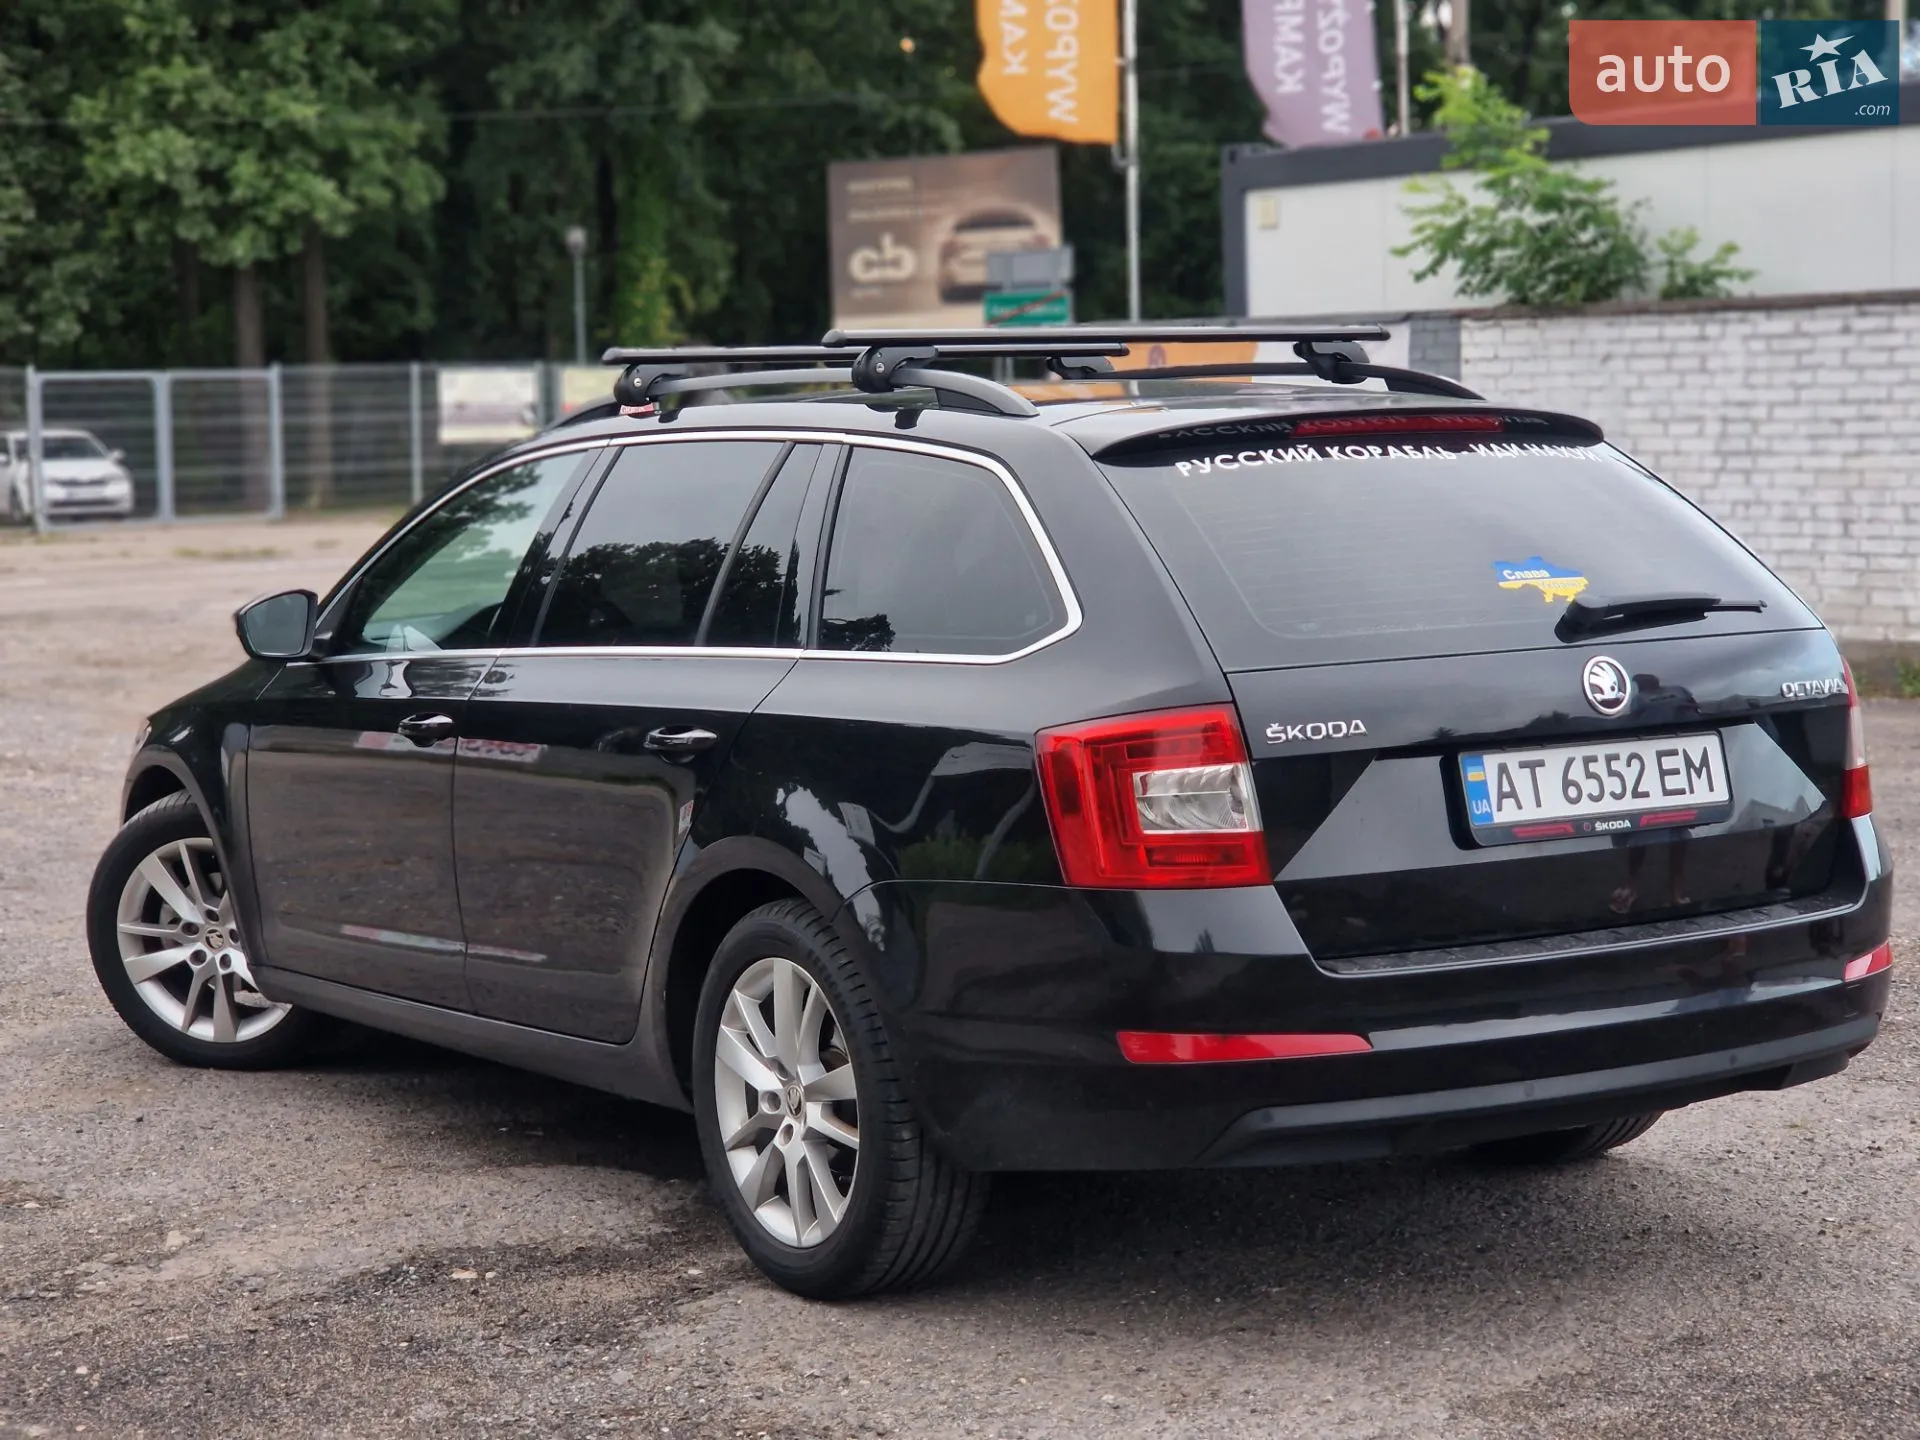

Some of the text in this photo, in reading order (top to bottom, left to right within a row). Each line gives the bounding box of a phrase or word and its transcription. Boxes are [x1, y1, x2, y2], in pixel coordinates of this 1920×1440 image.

[1175, 444, 1322, 477] РУССКИЙ
[1325, 445, 1457, 461] КОРАБЛЬ
[1781, 678, 1849, 698] OCTAVIA
[1265, 720, 1368, 744] ŠKODA
[1496, 746, 1715, 812] AT 6552 EM
[1472, 799, 1491, 815] UA
[1595, 820, 1632, 831] ŠKODA
